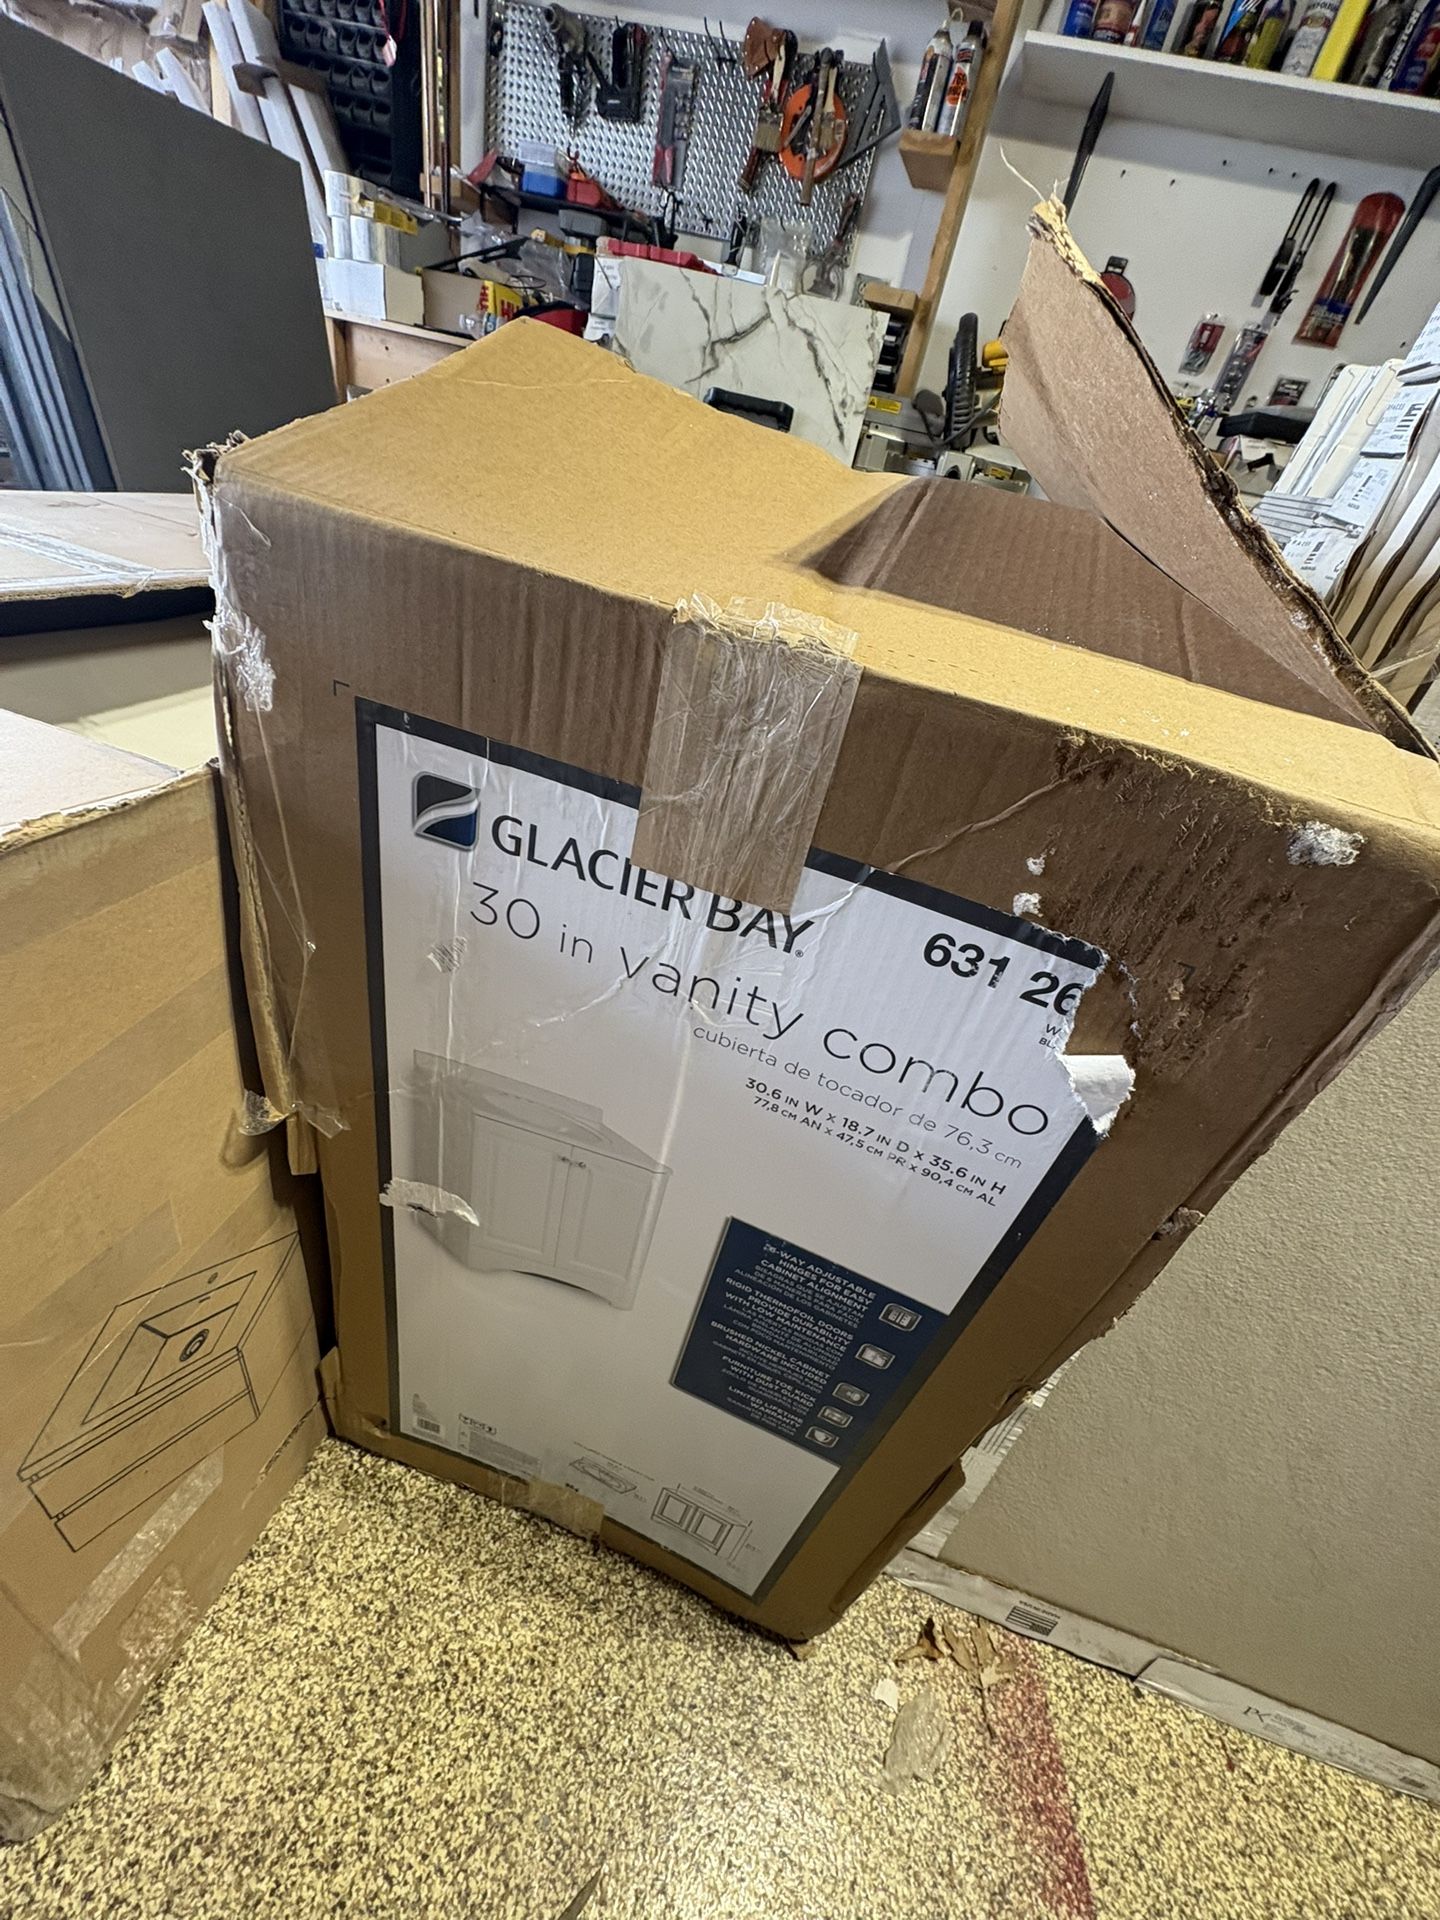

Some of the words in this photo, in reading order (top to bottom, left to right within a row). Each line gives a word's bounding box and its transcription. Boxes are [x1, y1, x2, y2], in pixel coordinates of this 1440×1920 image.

[491, 815, 694, 920] GLACIER
[706, 892, 814, 953] BAY
[924, 933, 1010, 988] 631
[470, 882, 540, 939] 30
[560, 924, 593, 964] in
[621, 947, 803, 1040] vanity
[823, 1028, 1049, 1136] combo
[692, 1026, 777, 1067] cubierta
[784, 1061, 811, 1080] de
[818, 1072, 904, 1117] tocador
[908, 1113, 937, 1132] de
[944, 1124, 993, 1154] 76,3
[994, 1150, 1022, 1169] cm
[745, 1077, 782, 1100] 30.6
[785, 1095, 800, 1108] IN
[805, 1101, 823, 1116] W
[842, 1117, 875, 1138] 18.7
[876, 1134, 892, 1146] IN
[896, 1140, 910, 1153] D
[929, 1154, 969, 1179] 35.6
[970, 1174, 987, 1187] IN
[990, 1181, 1007, 1195] H
[753, 1095, 780, 1113] 77,8
[781, 1109, 798, 1121] CM
[800, 1116, 823, 1131] AN
[836, 1132, 865, 1149] 47,5
[866, 1145, 884, 1157] CM
[887, 1151, 907, 1167] PR
[921, 1167, 954, 1187] 90,4
[956, 1184, 974, 1196] CM
[976, 1192, 998, 1207] AL
[725, 1276, 752, 1293] RIGID
[753, 1290, 817, 1323] THERMOFOIL
[816, 1319, 855, 1340] DOORS
[759, 1258, 805, 1283] CABINET
[806, 1279, 869, 1312] ALIGNMENT
[778, 1259, 817, 1281] HINGES
[818, 1277, 842, 1292] FOR
[842, 1288, 872, 1306] EASY
[805, 1263, 877, 1299] ADJUSTABLE
[724, 1291, 750, 1307] WITH
[751, 1303, 775, 1318] LOW
[775, 1315, 847, 1351] MAINTENANCE
[747, 1294, 791, 1318] PROVIDE
[791, 1315, 851, 1346] DURABILITY
[710, 1320, 753, 1344] BRUSHED
[754, 1341, 788, 1360] NICKEL
[788, 1357, 830, 1379] CABINET
[725, 1333, 779, 1362] HARDWARE
[779, 1359, 827, 1384] INCLUDED
[721, 1354, 773, 1382] FURNITURE
[773, 1379, 794, 1391] TOE
[793, 1388, 816, 1402] KICK
[728, 1385, 762, 1404] LIMITED
[763, 1402, 803, 1423] LIFETIME
[729, 1364, 753, 1379] WITH
[754, 1376, 778, 1391] DUST
[780, 1388, 813, 1407] GUARD
